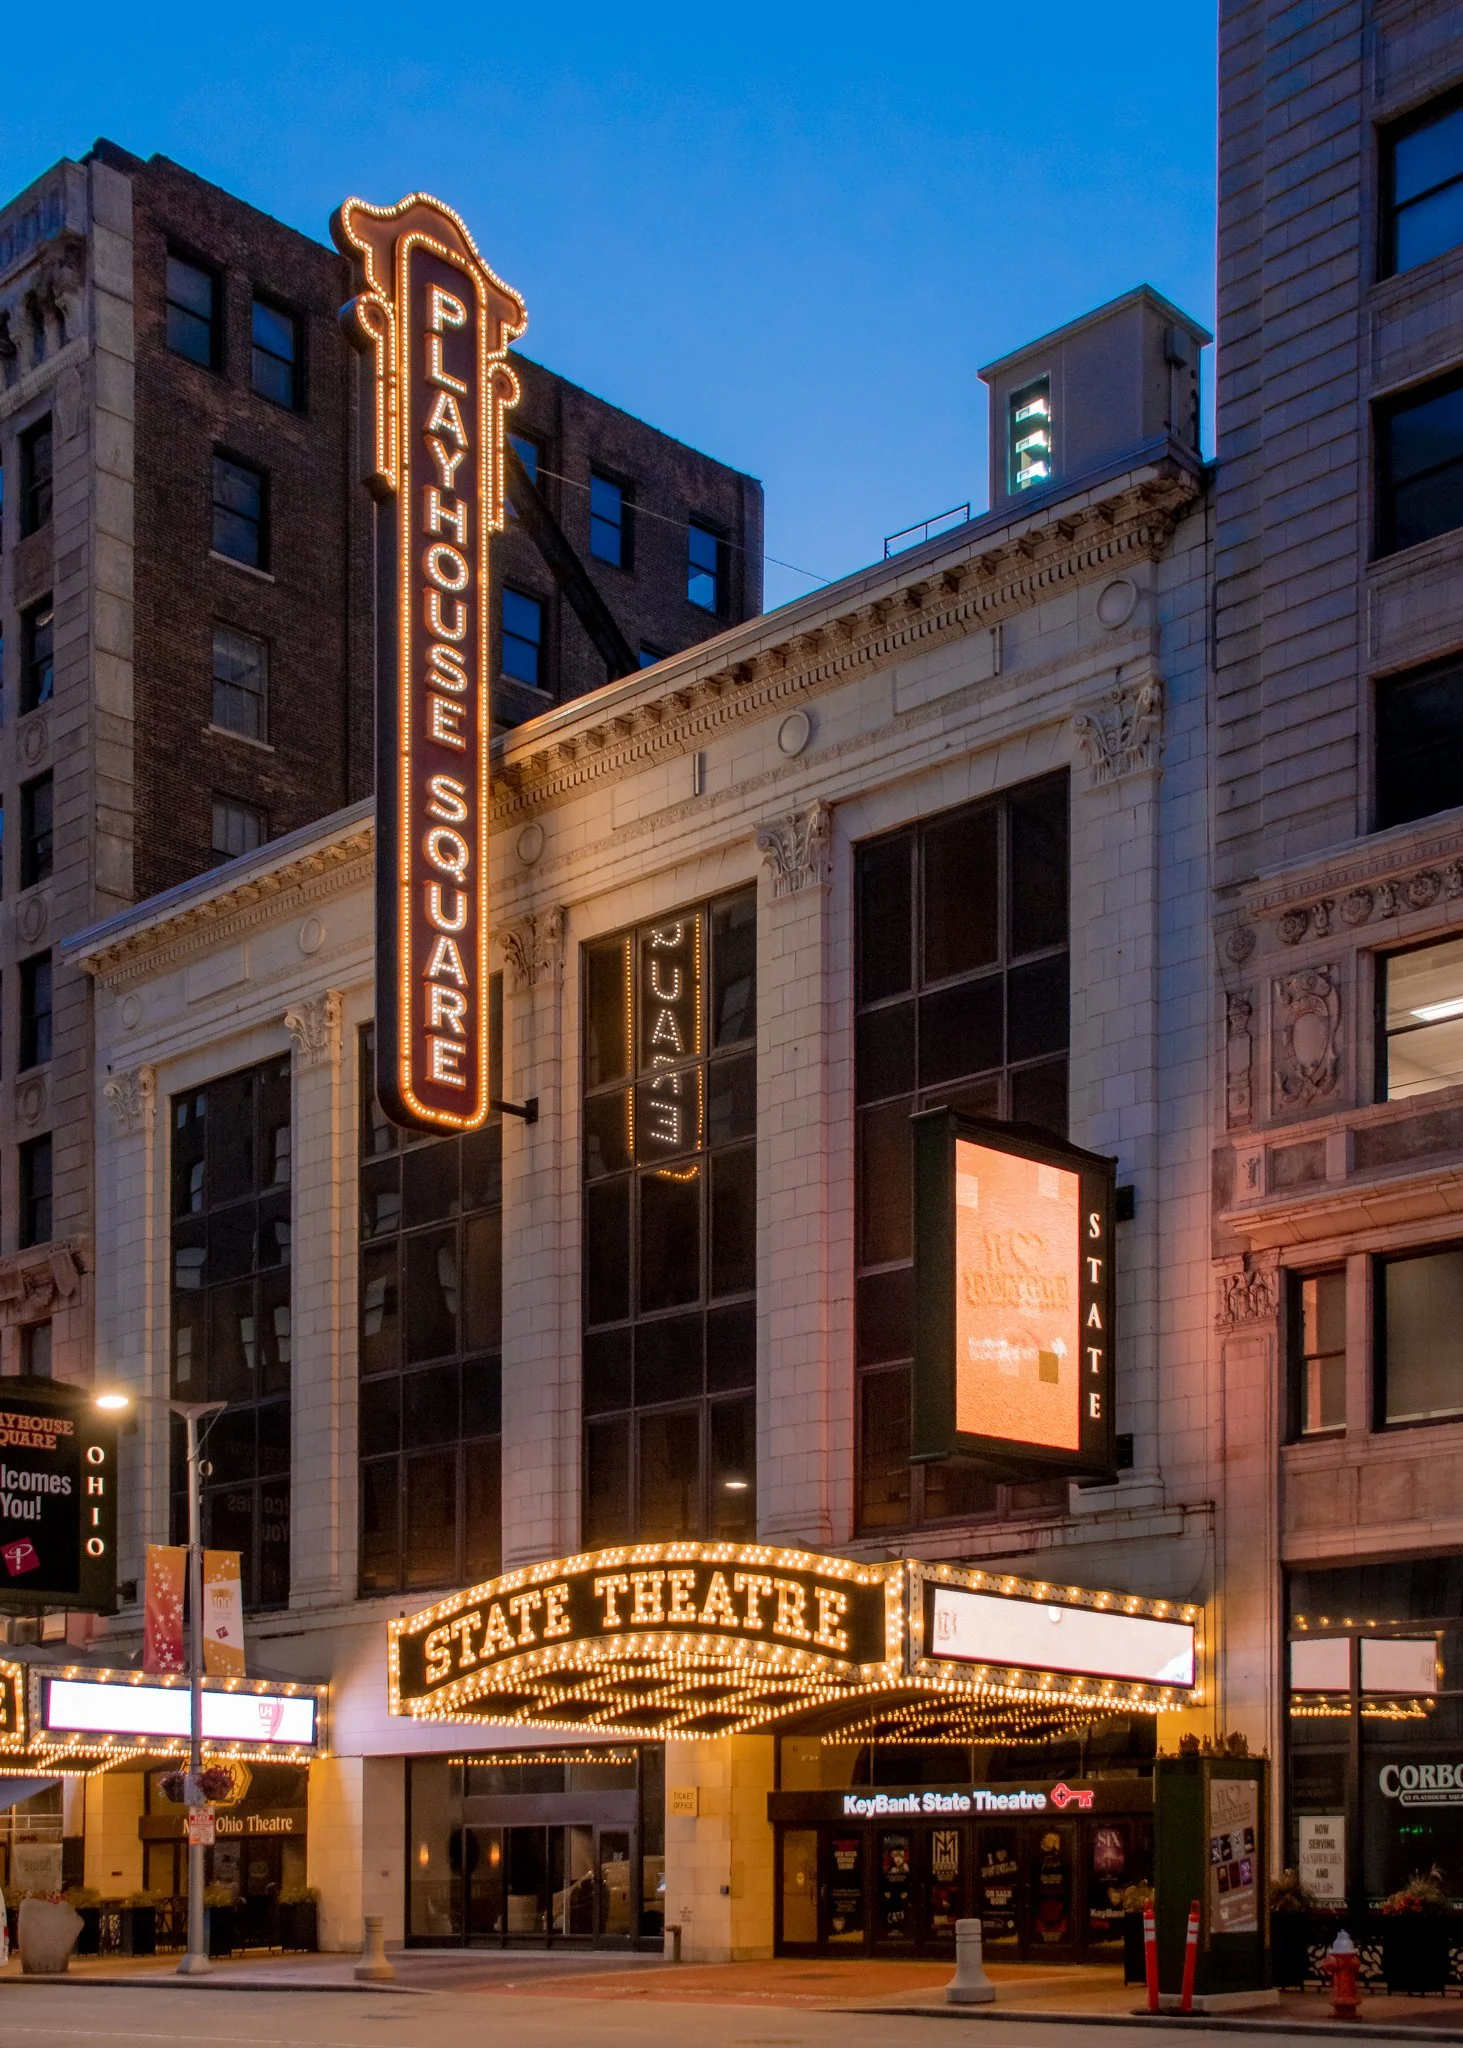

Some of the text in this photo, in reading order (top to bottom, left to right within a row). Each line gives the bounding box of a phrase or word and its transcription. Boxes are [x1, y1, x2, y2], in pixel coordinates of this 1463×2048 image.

[421, 282, 470, 1090] PLAYHOUSE SQUARE
[1086, 1213, 1103, 1419] STATE
[1, 1464, 72, 1495] lcomes
[0, 1492, 42, 1520] You!
[86, 1446, 105, 1556] OHIO
[424, 1568, 849, 1685] STATE THEATRE
[673, 1792, 694, 1800] TICKET
[844, 1790, 1047, 1818] KeyBank State Theatre
[673, 1802, 694, 1810] OFFICE
[216, 1815, 243, 1833] Ohio
[247, 1814, 293, 1832] Theatre
[1314, 1824, 1329, 1834] NOW
[1097, 1831, 1121, 1847] SIX
[1308, 1838, 1336, 1849] SERVING
[1302, 1852, 1342, 1865] SANDWICHES
[1315, 1867, 1329, 1878] AND
[887, 1910, 905, 1924] CATS
